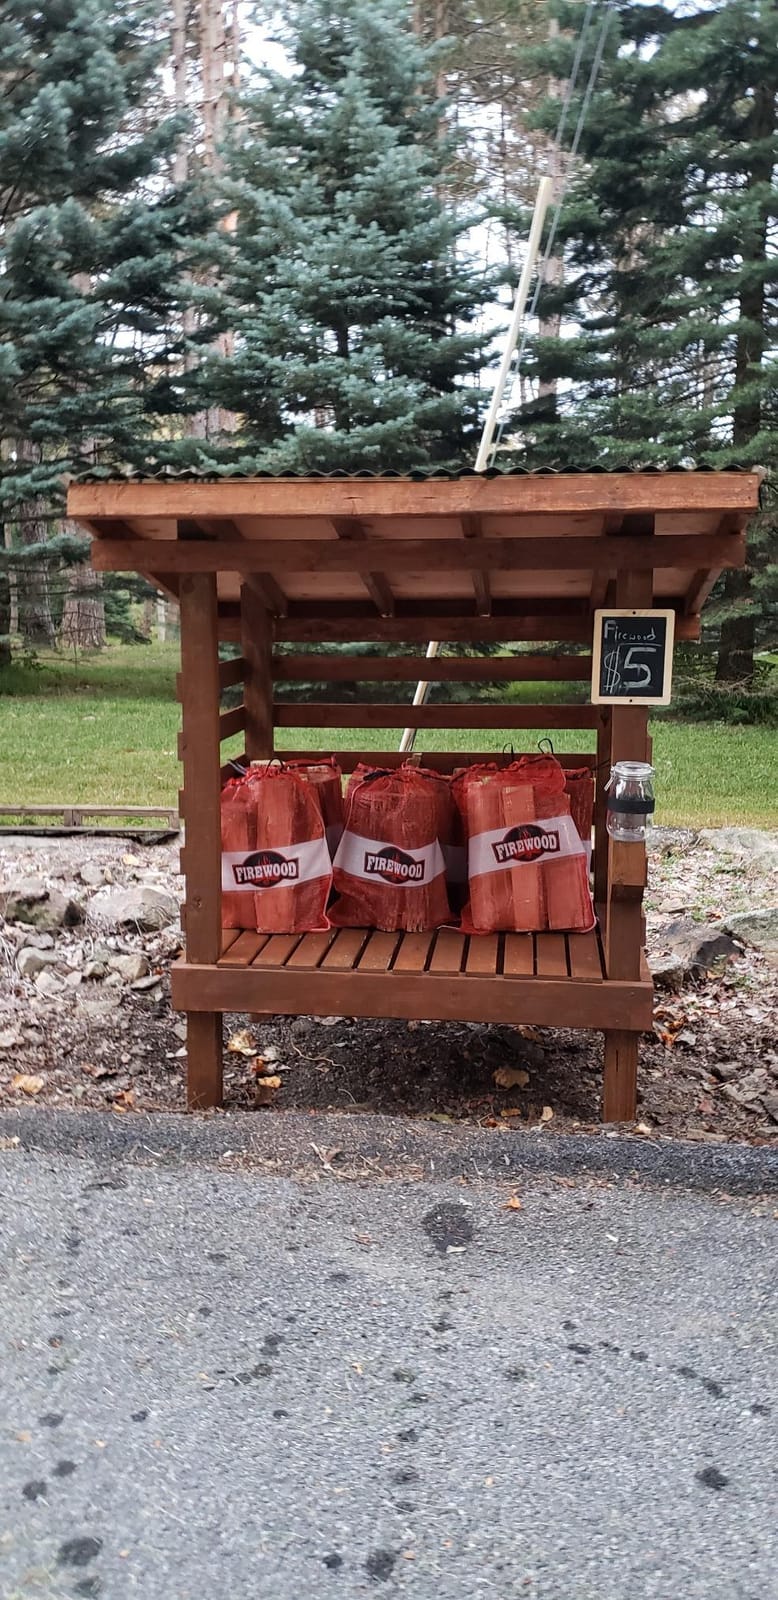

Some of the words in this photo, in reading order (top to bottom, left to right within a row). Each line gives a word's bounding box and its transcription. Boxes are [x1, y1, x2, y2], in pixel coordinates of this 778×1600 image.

[604, 620, 657, 641] Firewood
[603, 645, 657, 694] $5
[495, 834, 557, 861] FIREWOOD
[235, 861, 297, 882] FIREWOOD
[366, 855, 422, 878] FIREWOOD
